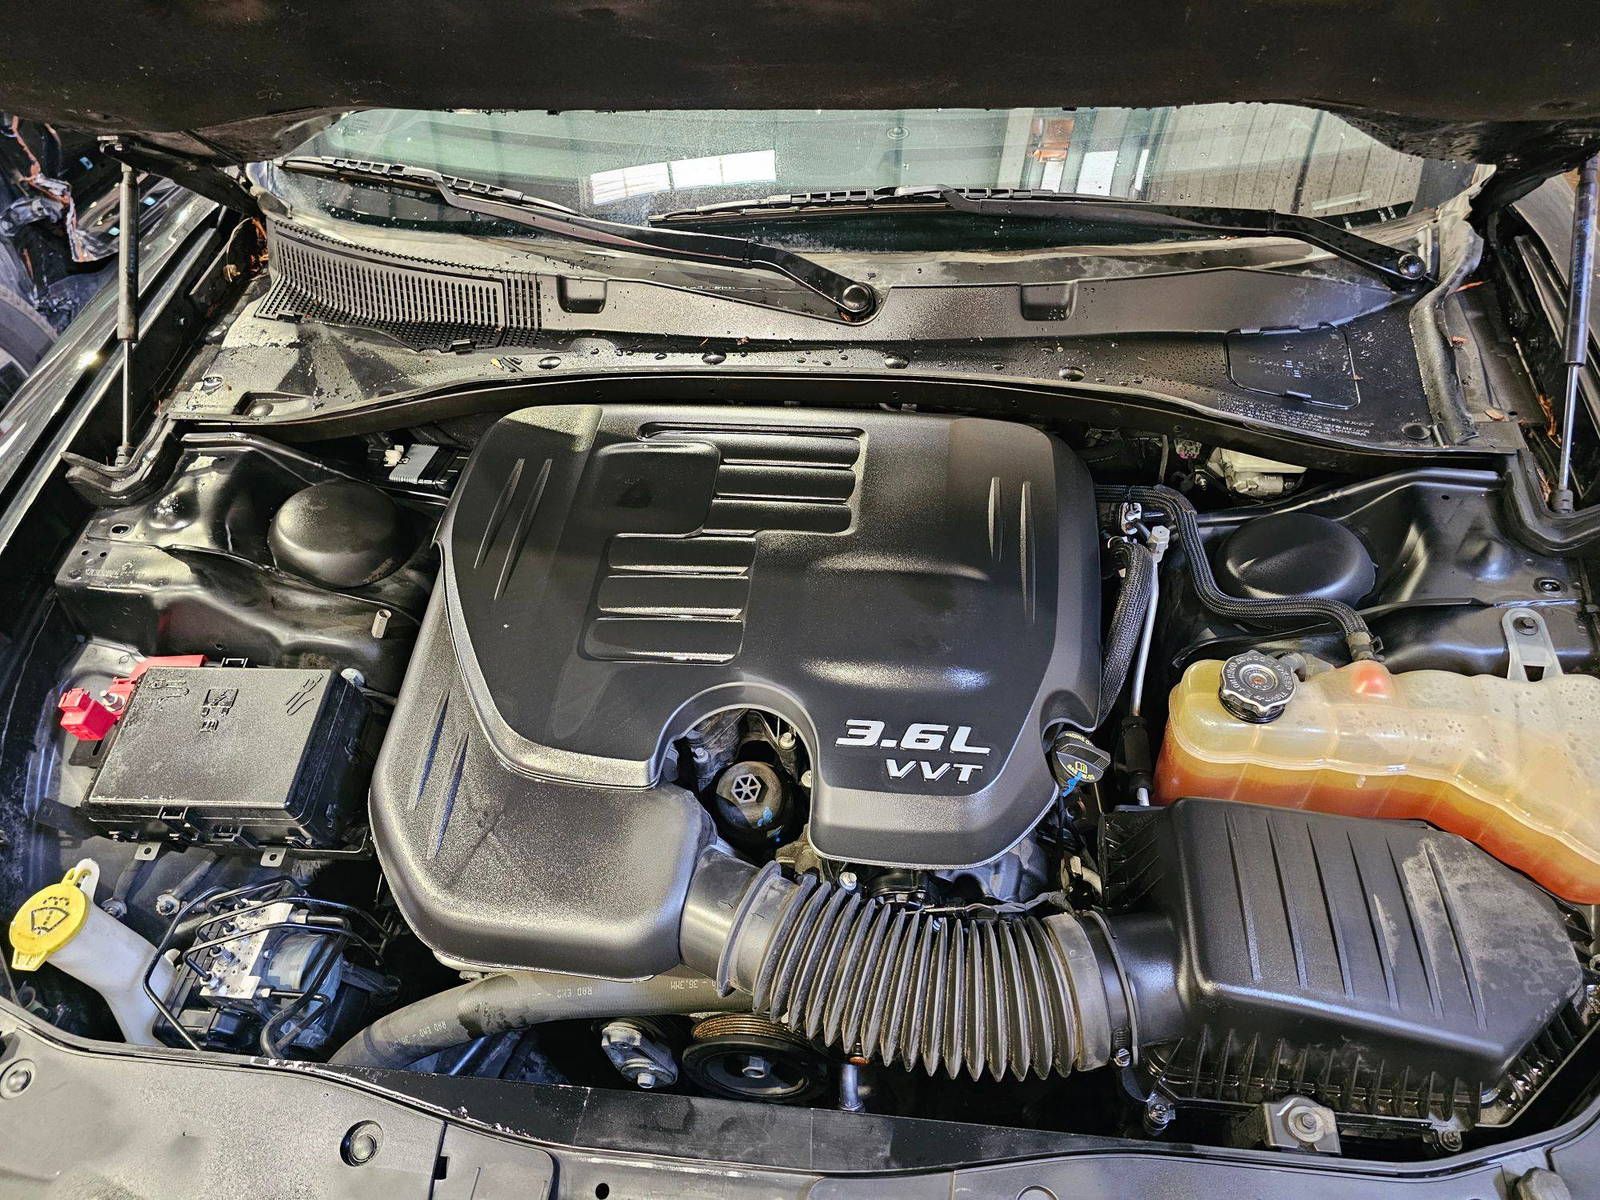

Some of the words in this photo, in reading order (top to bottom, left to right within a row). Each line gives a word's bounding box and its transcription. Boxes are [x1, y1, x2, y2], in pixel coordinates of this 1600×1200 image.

[835, 718, 992, 755] 3.6L
[884, 758, 984, 784] VVT
[577, 986, 593, 996] RAD
